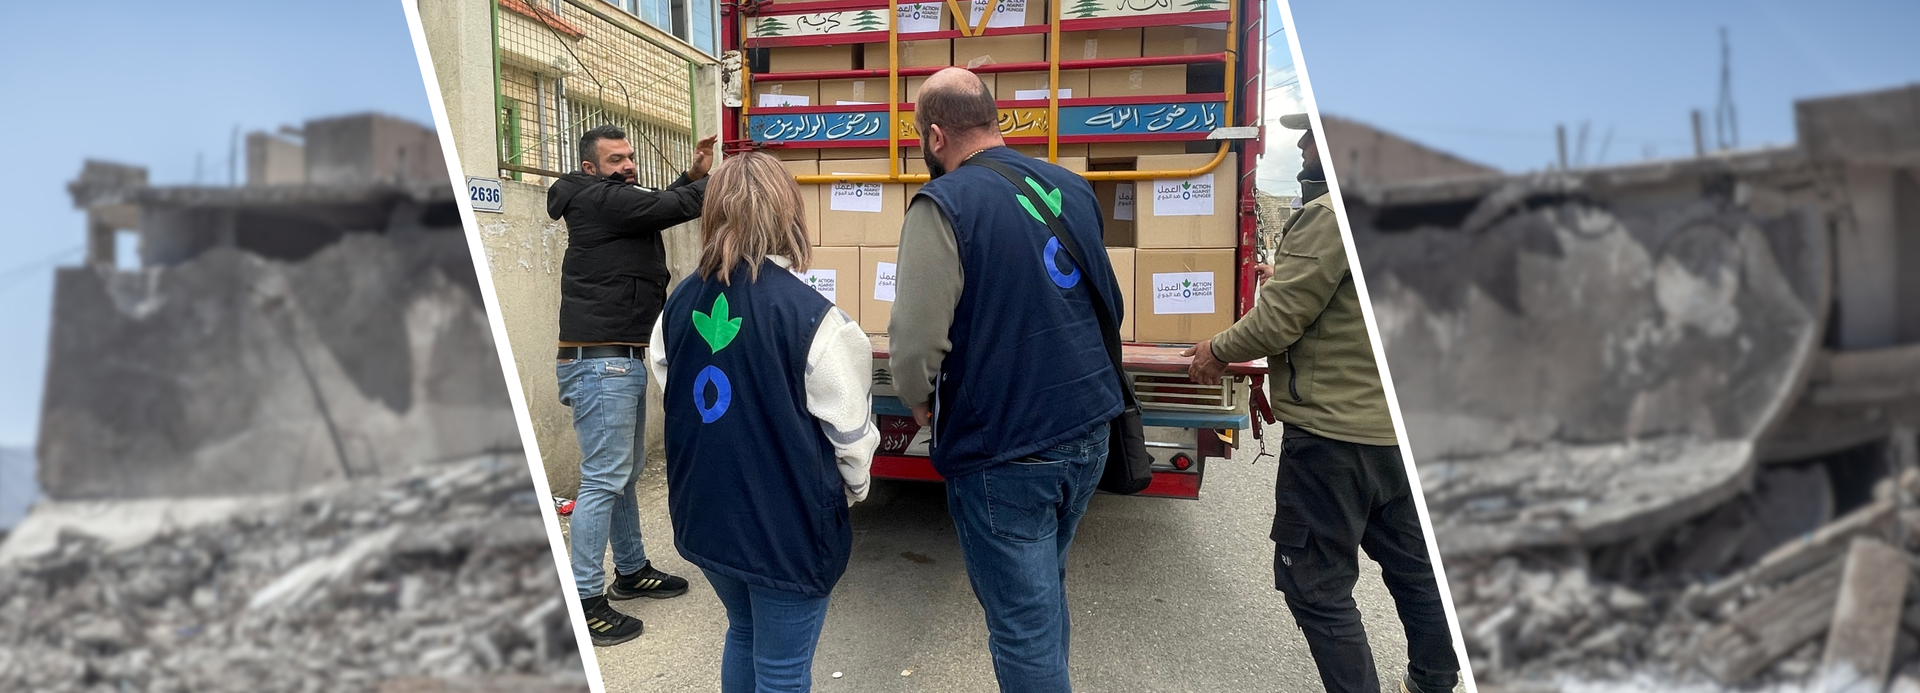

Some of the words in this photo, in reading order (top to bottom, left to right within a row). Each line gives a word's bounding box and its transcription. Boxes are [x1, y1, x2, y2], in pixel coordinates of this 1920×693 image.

[1157, 184, 1181, 194] العمل
[470, 186, 500, 203] 2636
[1157, 283, 1181, 292] العمل
